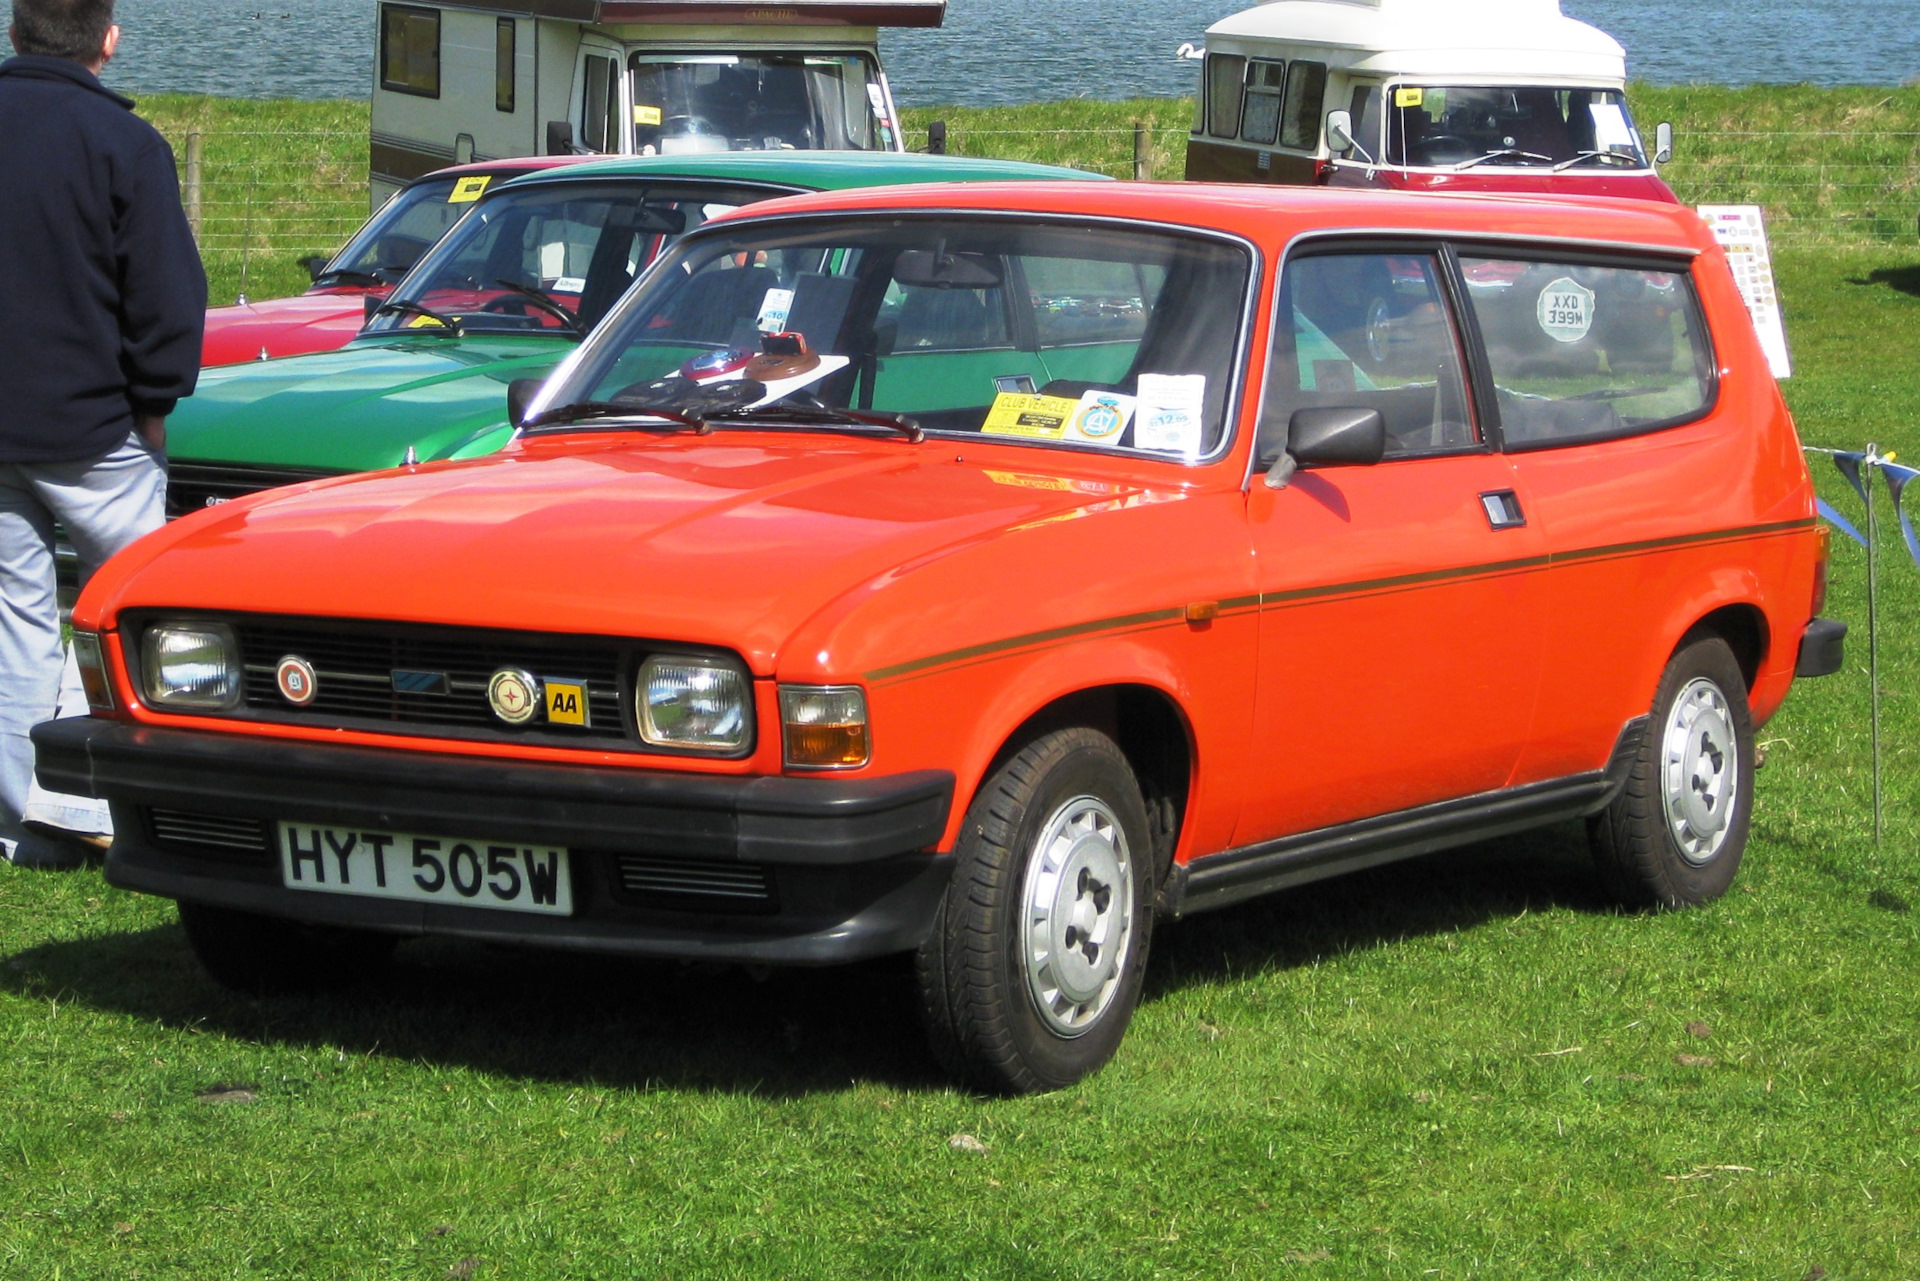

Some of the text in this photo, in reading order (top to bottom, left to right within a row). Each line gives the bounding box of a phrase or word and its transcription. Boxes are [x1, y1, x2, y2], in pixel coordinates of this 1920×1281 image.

[1553, 295, 1578, 309] XXD
[1001, 396, 1069, 414] CLUB VEHICLE
[551, 692, 578, 714] AA
[288, 827, 558, 906] HYT 505W
